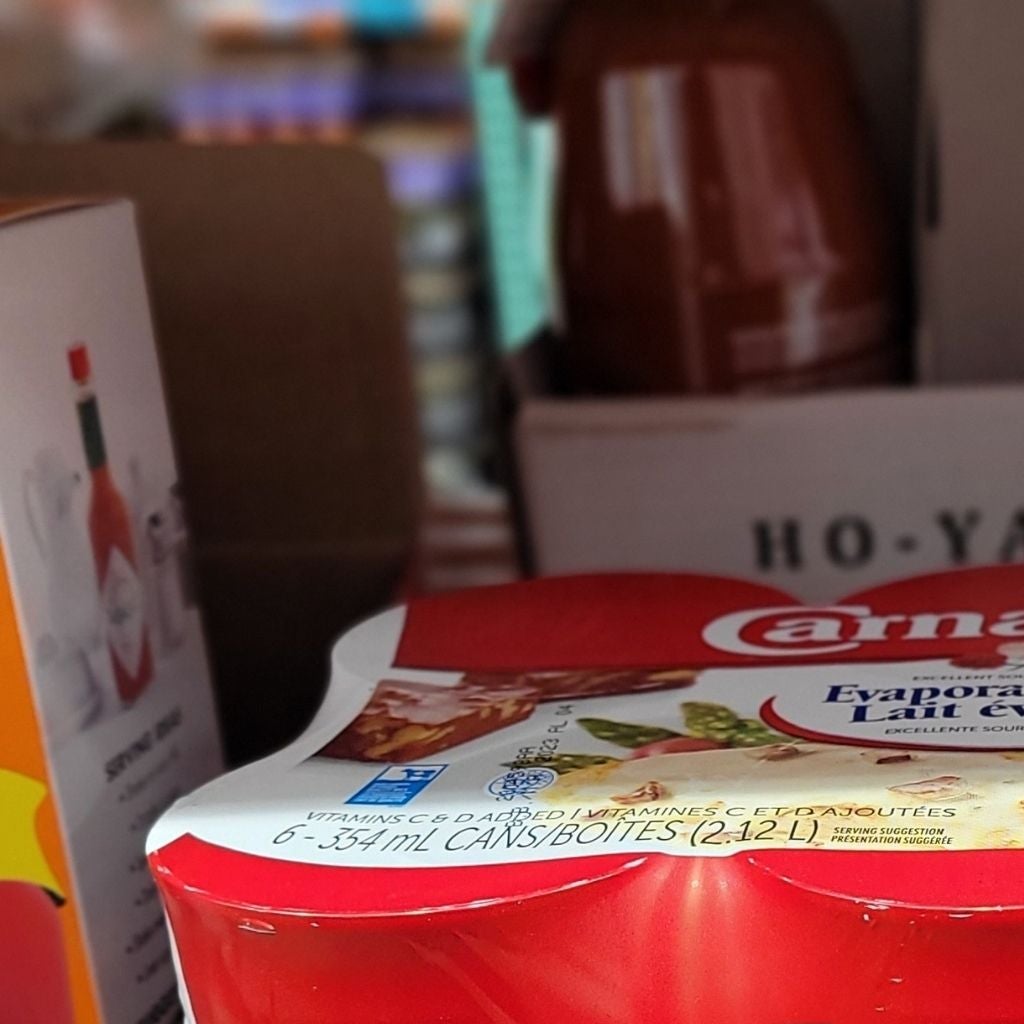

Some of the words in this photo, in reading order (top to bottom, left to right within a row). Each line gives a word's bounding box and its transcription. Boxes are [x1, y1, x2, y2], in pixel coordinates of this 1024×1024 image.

[848, 699, 962, 724] Lait
[885, 725, 979, 735] EXCELLENTE
[306, 811, 402, 825] VITAMINS
[408, 814, 427, 824] C
[431, 813, 450, 823] &
[454, 812, 475, 823] D
[586, 806, 717, 820] VITAMINES
[725, 807, 747, 817] C
[752, 807, 782, 817] ET
[793, 807, 817, 817] D
[821, 804, 957, 818] AJOUTÉES
[271, 823, 307, 845] 6
[317, 824, 384, 851] 354
[383, 827, 440, 852] mL
[443, 816, 687, 852] CANS/BOÎTES
[689, 818, 777, 847] (2.12
[786, 819, 820, 844] L)
[833, 826, 878, 836] SERVING
[879, 827, 946, 837] SUGGESTION
[830, 834, 902, 846] PRÉSENTATION
[902, 835, 955, 847] SUGGÉRÉE
